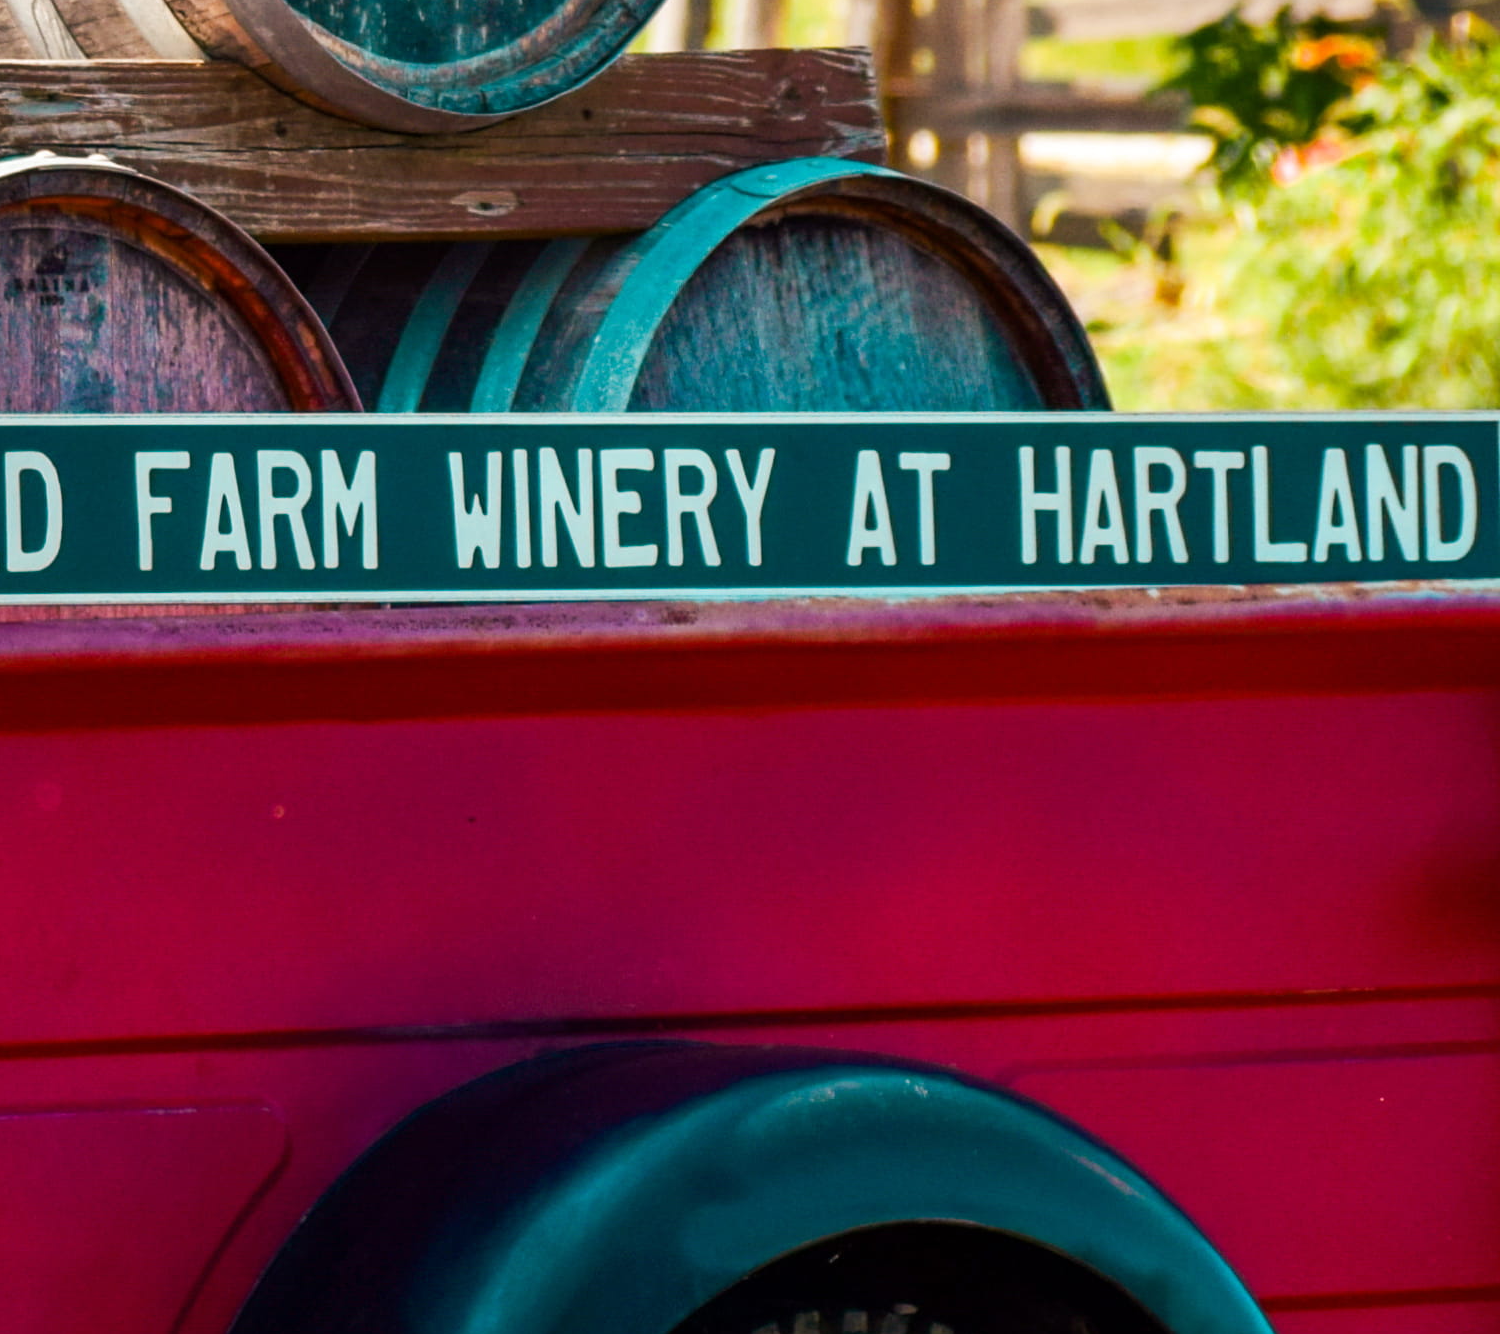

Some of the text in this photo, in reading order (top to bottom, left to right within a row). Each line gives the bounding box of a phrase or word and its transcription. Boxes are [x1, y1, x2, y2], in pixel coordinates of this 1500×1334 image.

[134, 449, 379, 571] FARM
[447, 447, 776, 568] WINERY
[846, 449, 951, 566] AT
[1019, 444, 1478, 564] HARTLAND
